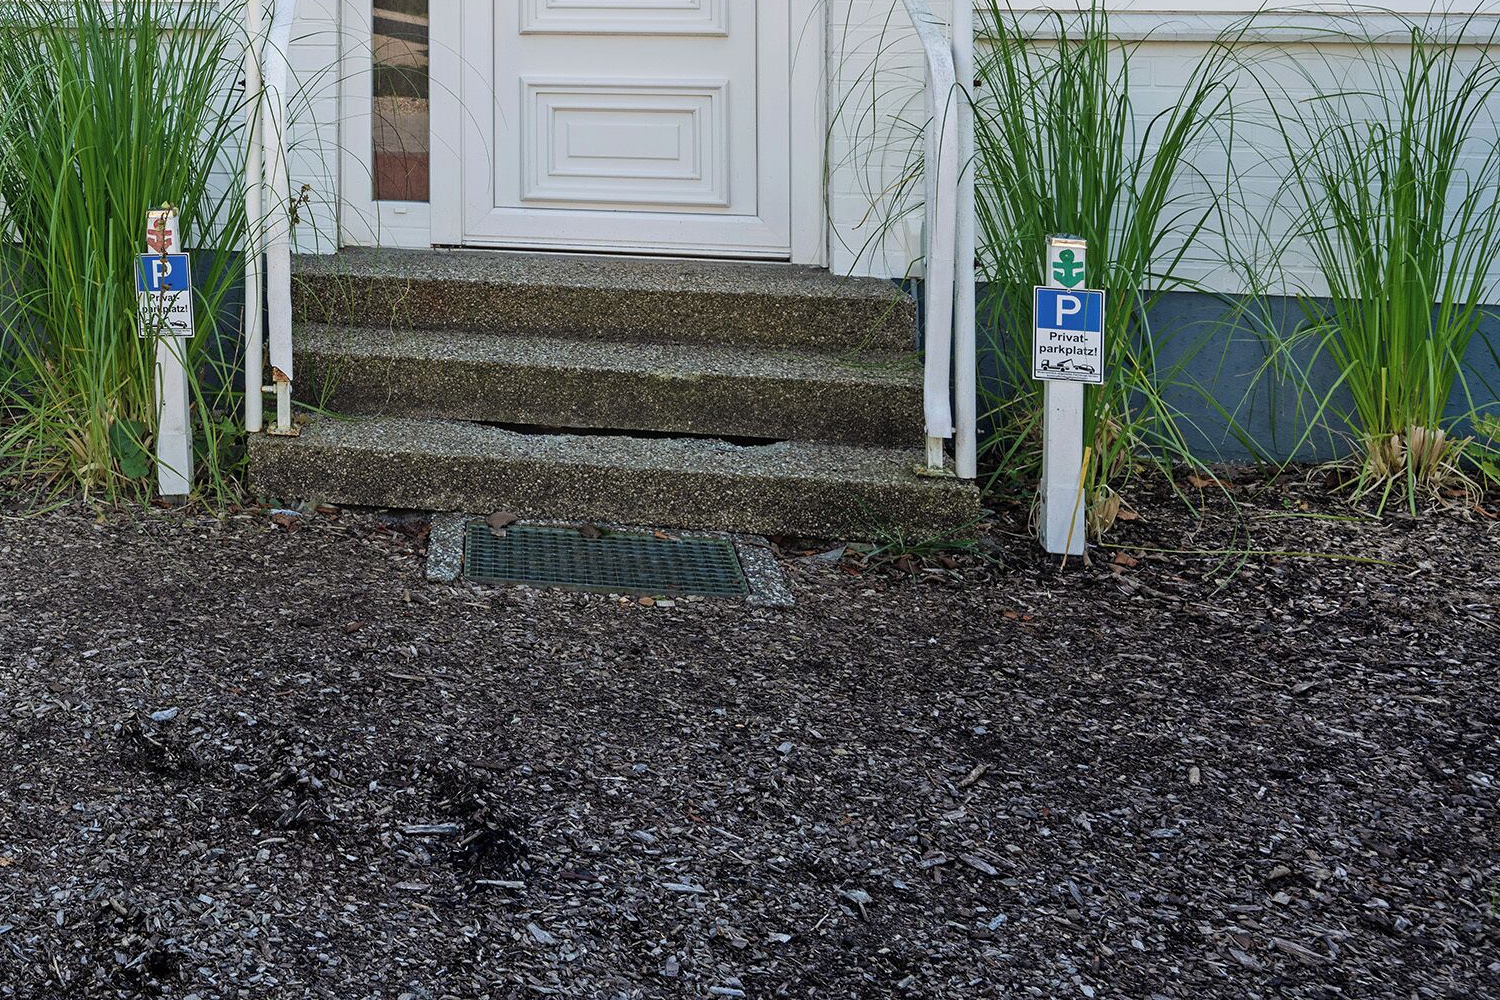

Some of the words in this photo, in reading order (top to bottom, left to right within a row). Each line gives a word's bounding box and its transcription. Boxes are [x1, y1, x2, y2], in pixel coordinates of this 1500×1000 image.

[151, 259, 172, 288] P
[149, 293, 180, 302] Prvat-
[1056, 294, 1082, 326] P
[1049, 331, 1088, 343] Privat-
[1039, 344, 1098, 357] parkplatz!
